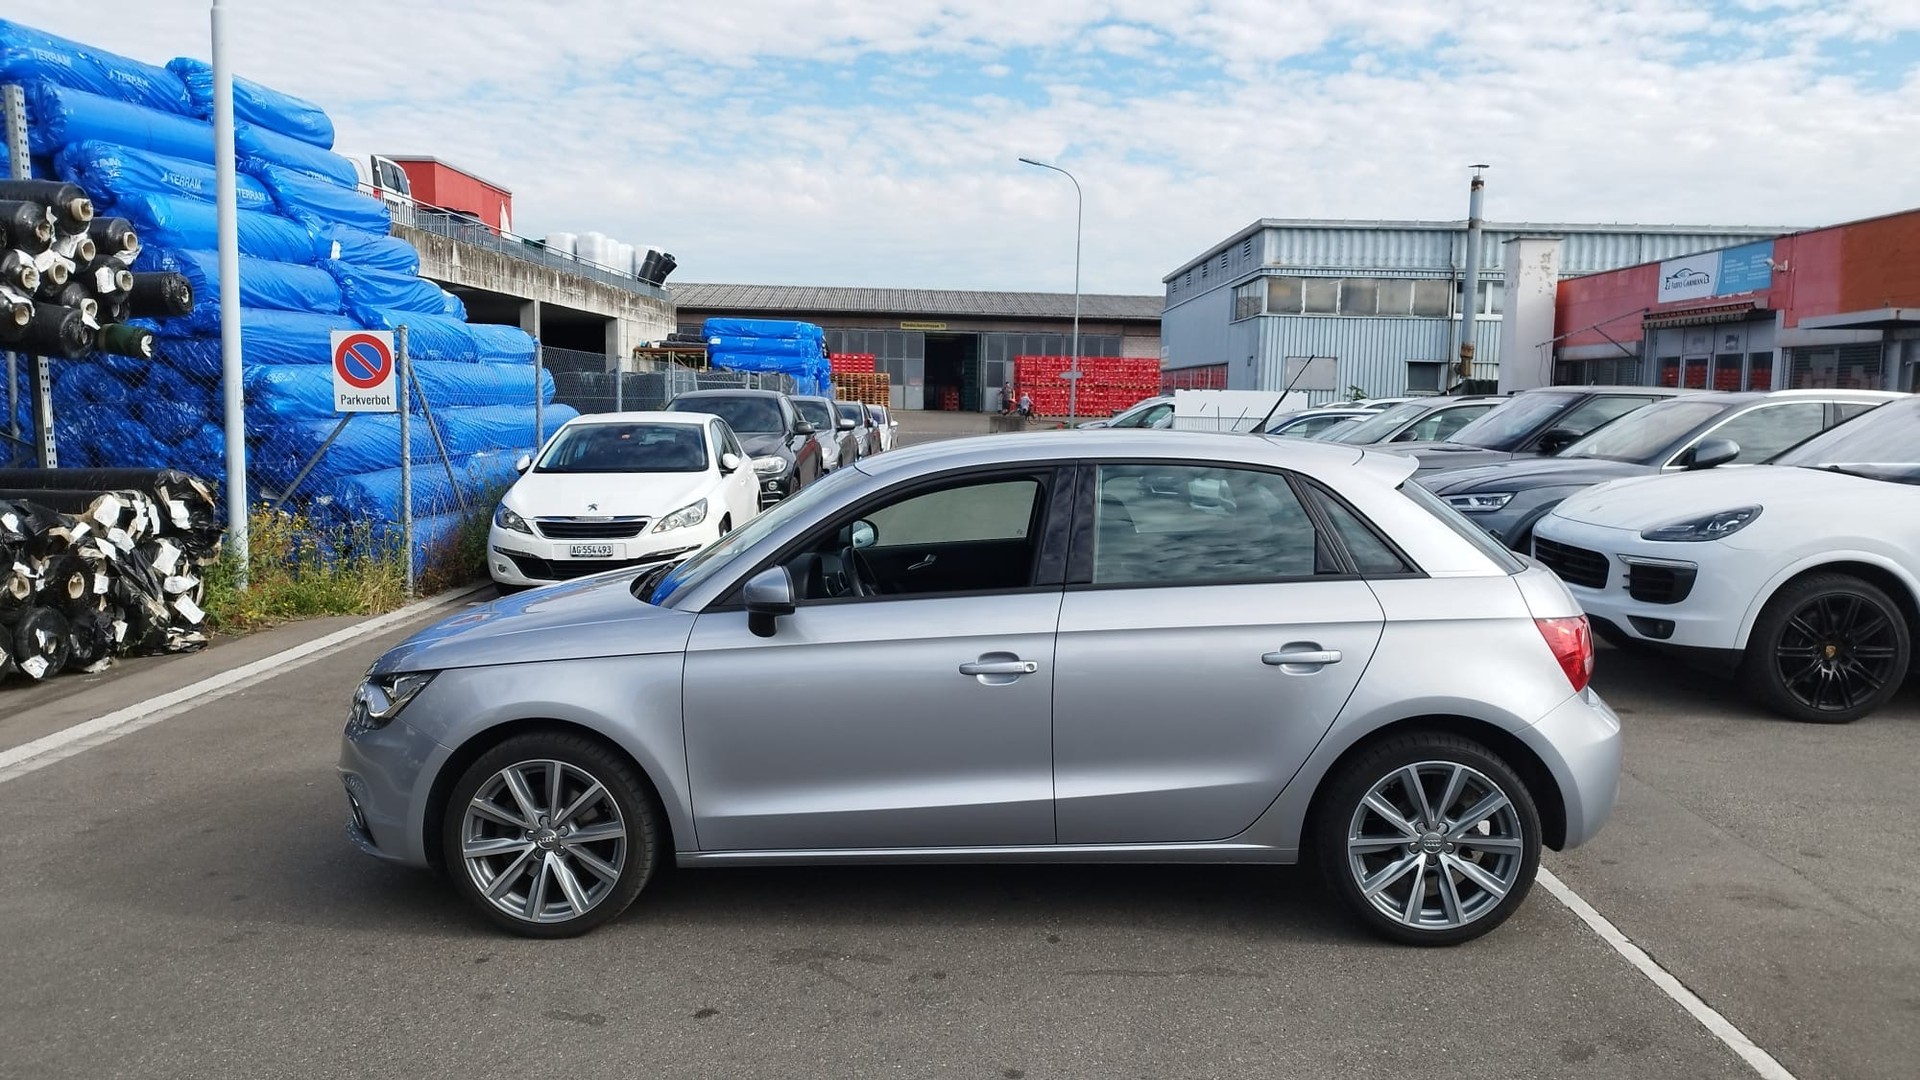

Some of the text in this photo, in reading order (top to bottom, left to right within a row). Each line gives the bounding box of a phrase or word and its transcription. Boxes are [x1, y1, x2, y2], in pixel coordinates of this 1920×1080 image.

[169, 173, 202, 190] TERRAM
[236, 188, 266, 202] TERRAM
[340, 394, 391, 405] Parkverbot
